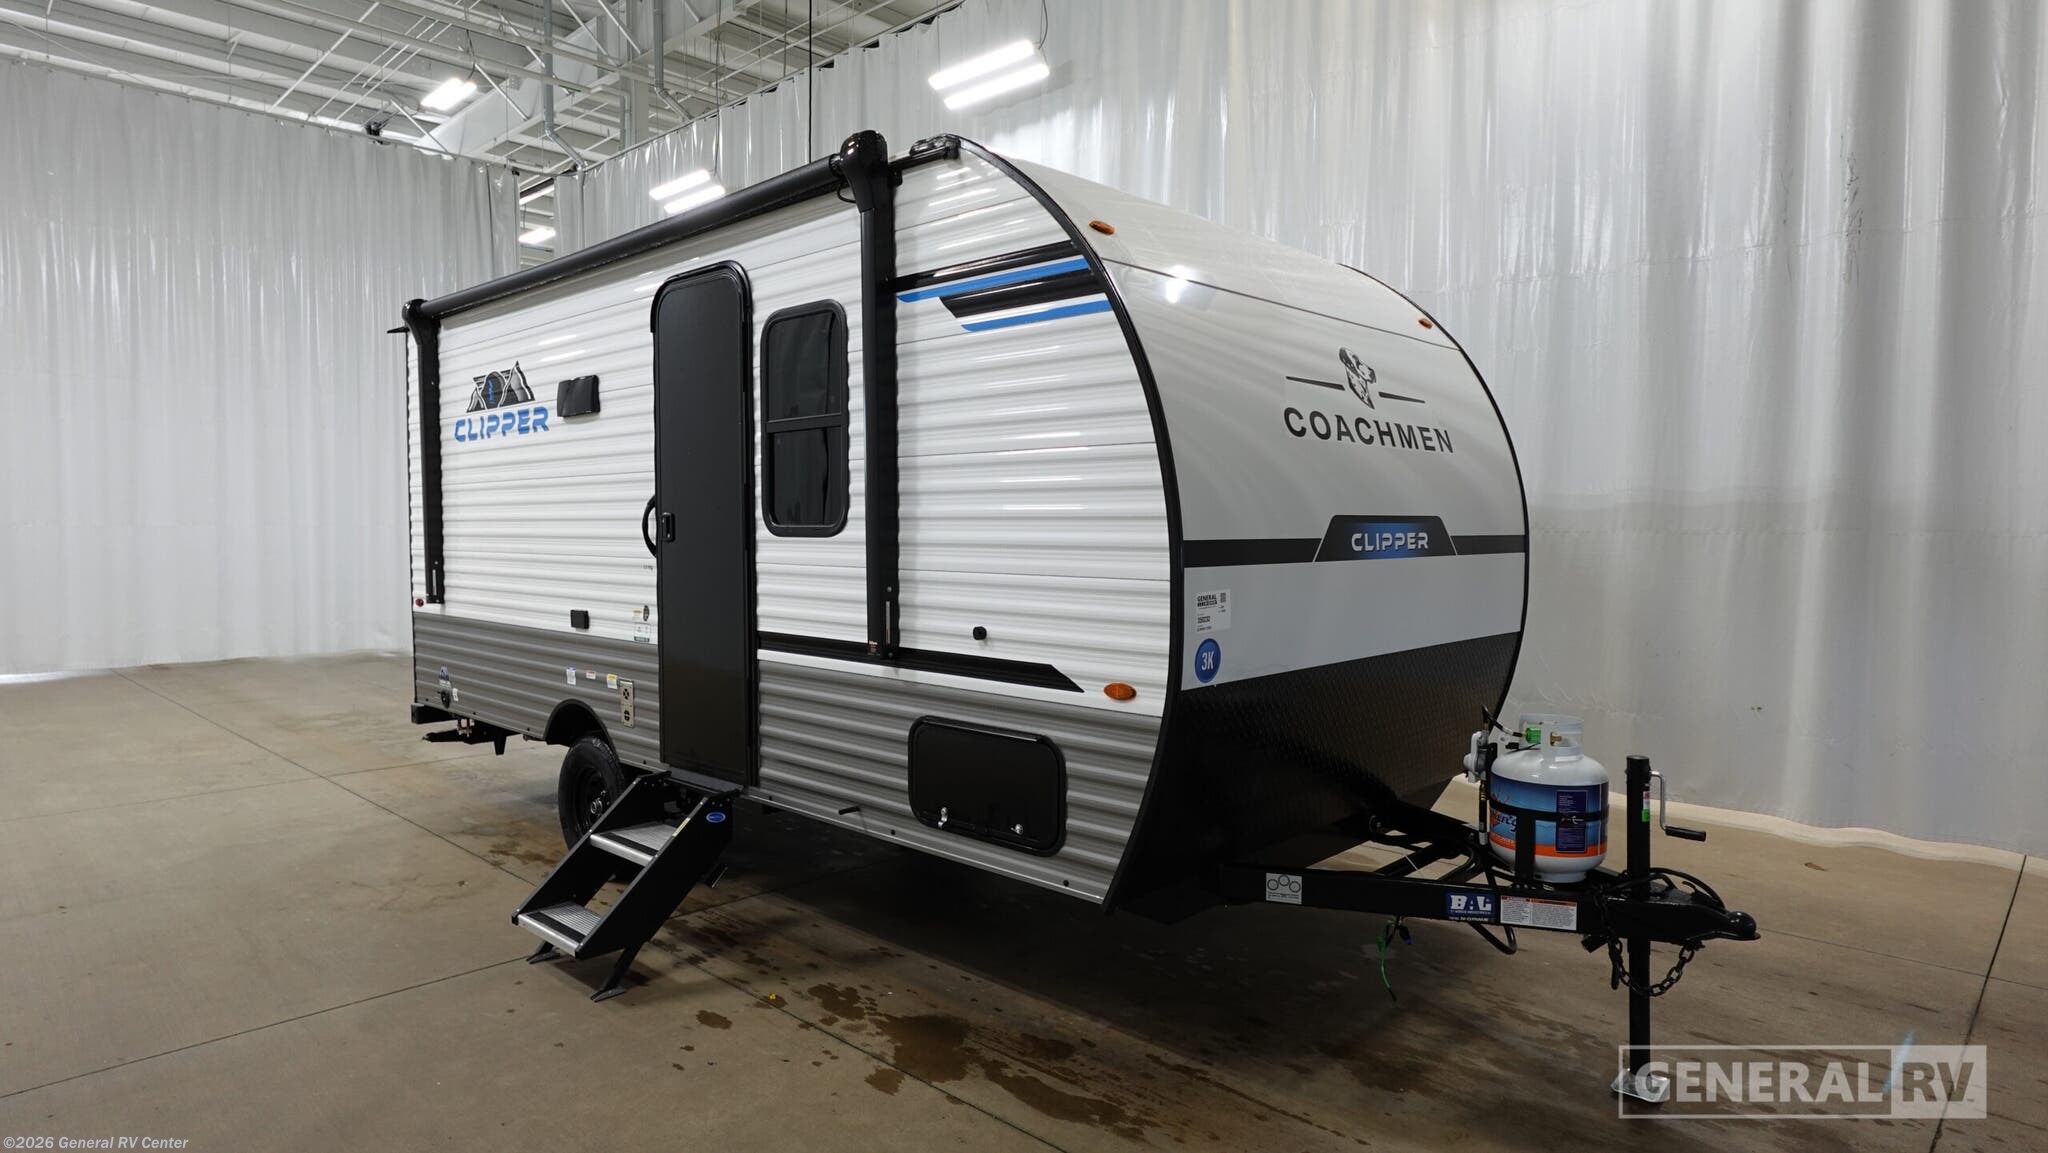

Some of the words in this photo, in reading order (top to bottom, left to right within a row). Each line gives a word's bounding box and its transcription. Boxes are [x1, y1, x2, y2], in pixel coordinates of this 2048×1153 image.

[454, 406, 549, 442] CLIPPER
[1284, 407, 1454, 453] COACHMEN
[1351, 532, 1429, 551] CLIPPER
[1201, 651, 1215, 671] 3K
